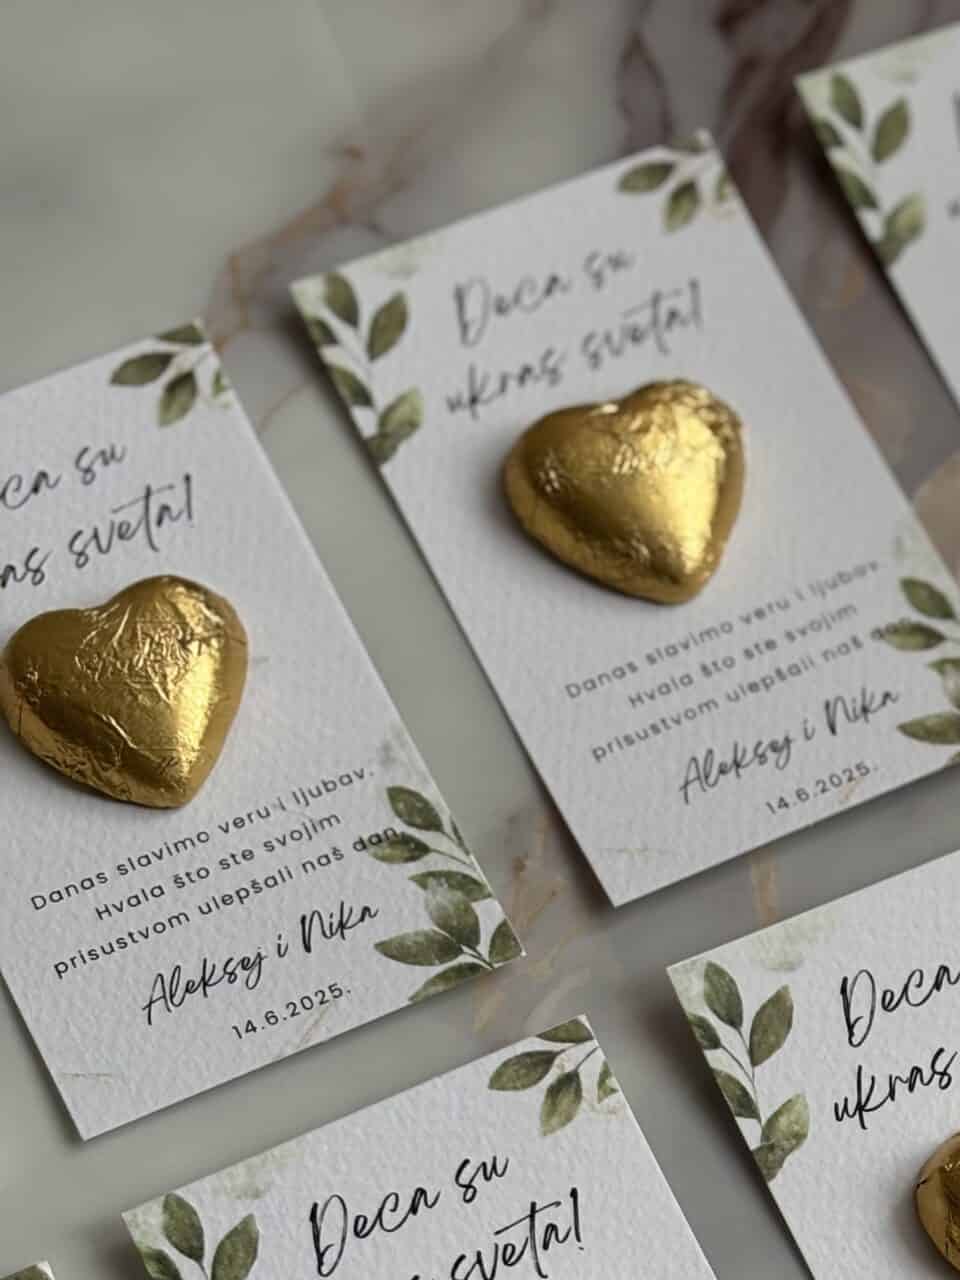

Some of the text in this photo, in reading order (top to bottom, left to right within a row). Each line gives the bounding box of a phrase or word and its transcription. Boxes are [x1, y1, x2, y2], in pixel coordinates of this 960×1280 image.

[0, 443, 126, 510] ca su
[67, 472, 194, 569] sveta!
[30, 872, 108, 911] Danas
[116, 831, 210, 876] slavimo
[217, 806, 271, 834] veru
[277, 796, 287, 813] i
[95, 814, 340, 921] Hvala što ste svojim
[53, 911, 190, 979] prisustvom
[197, 866, 293, 915] ulepšali
[301, 846, 344, 873] naš
[141, 901, 379, 1026] Aleksej i Nika
[833, 1047, 958, 1130] ukras
[308, 1154, 508, 1278] Deca su
